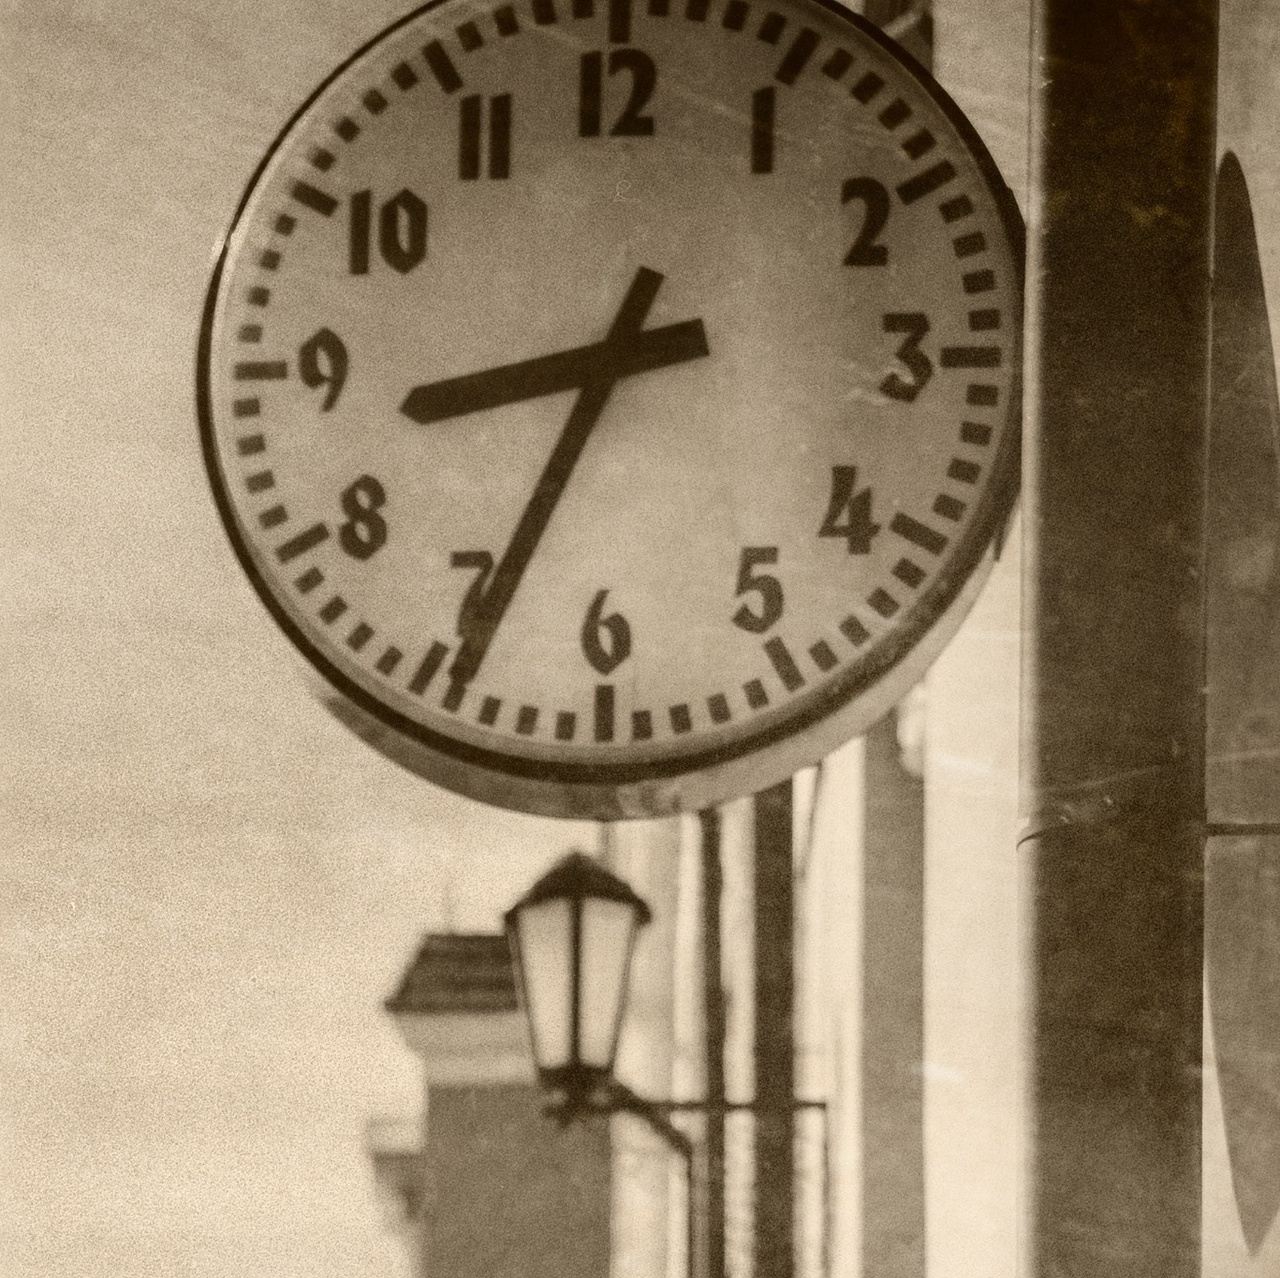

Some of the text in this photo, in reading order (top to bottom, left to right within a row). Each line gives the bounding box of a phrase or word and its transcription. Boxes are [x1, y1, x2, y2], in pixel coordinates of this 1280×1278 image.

[459, 93, 513, 180] 11
[579, 48, 657, 137] 12
[751, 86, 776, 174] 1
[348, 187, 428, 275] 10
[840, 176, 892, 267] 2
[298, 327, 349, 412] 9
[879, 313, 933, 403] 3
[338, 474, 388, 561] 8
[818, 465, 882, 555] 4
[450, 551, 495, 638] 7
[580, 589, 632, 677] 6
[731, 546, 784, 633] 5
